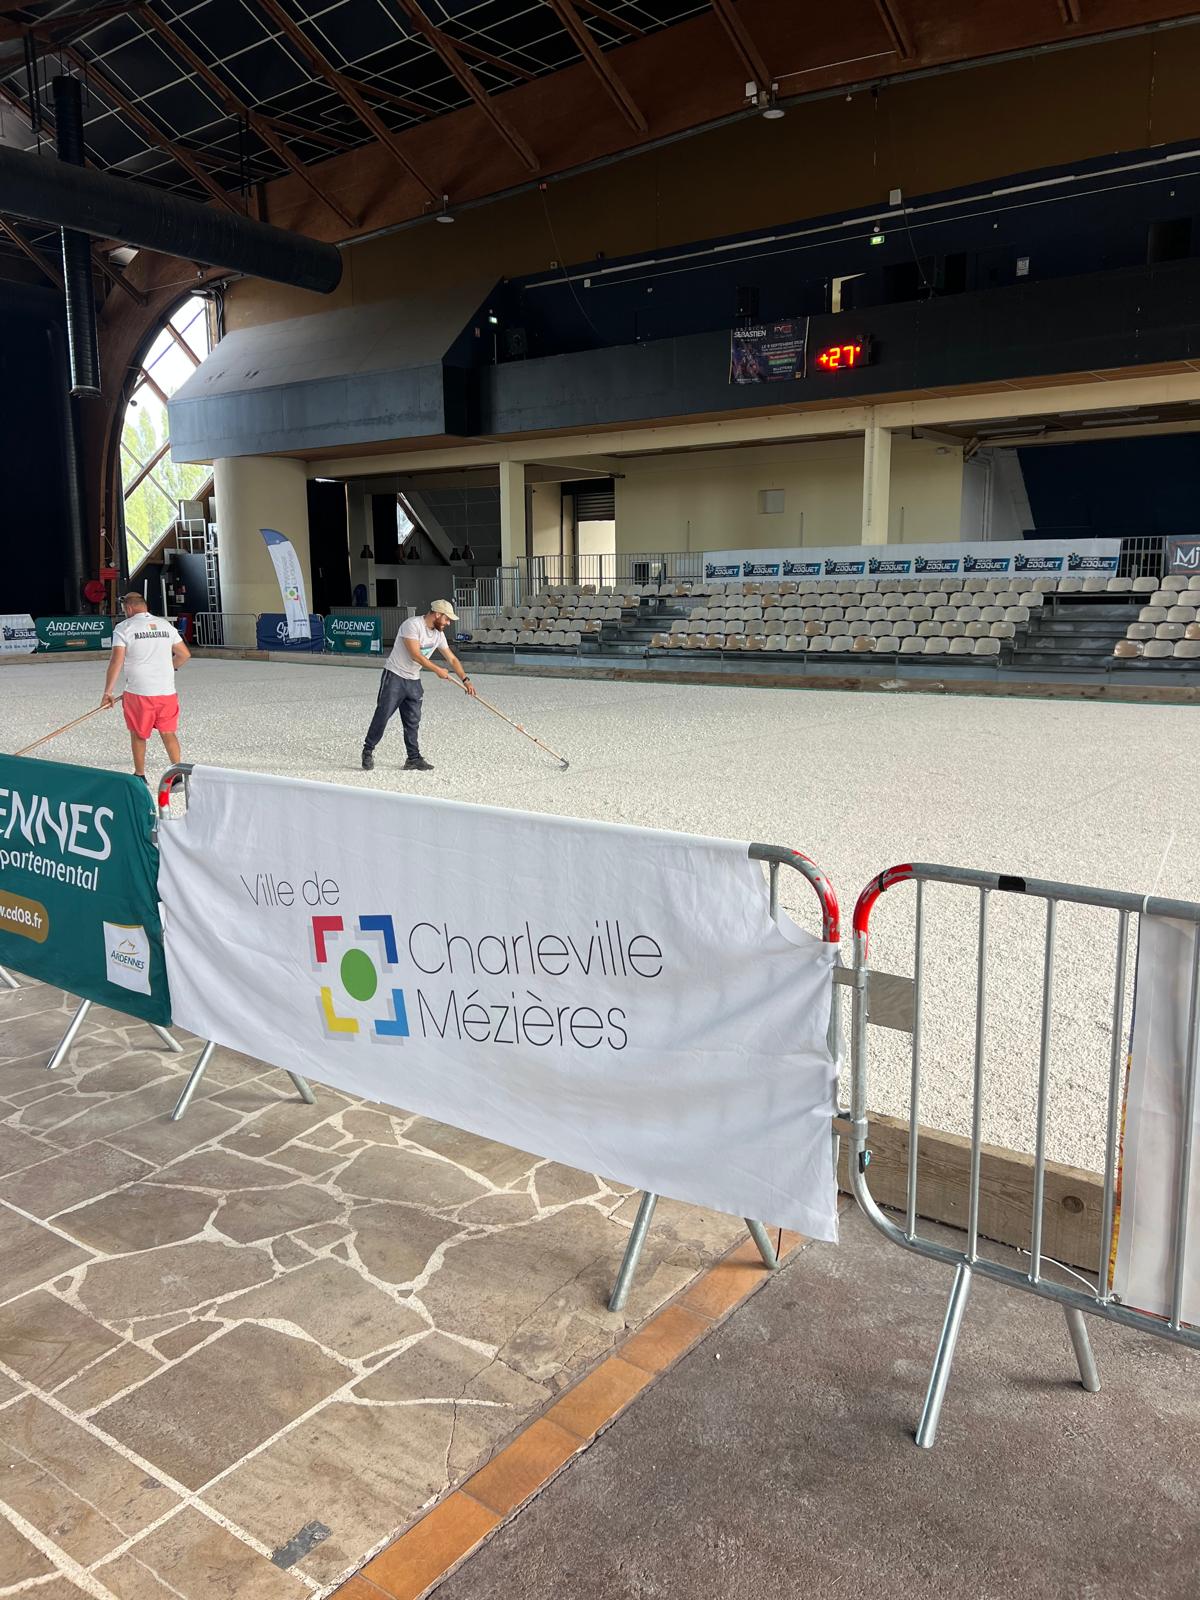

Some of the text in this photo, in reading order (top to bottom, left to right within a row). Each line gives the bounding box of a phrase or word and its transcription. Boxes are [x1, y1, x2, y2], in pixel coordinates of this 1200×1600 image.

[1080, 560, 1116, 568] COQUET
[46, 621, 104, 632] ARDENNES
[331, 619, 375, 631] ARDENNES
[240, 871, 340, 907] Ville de
[408, 920, 663, 978] Charleville
[111, 950, 144, 970] ARDENNES
[416, 988, 628, 1050] Mézières
